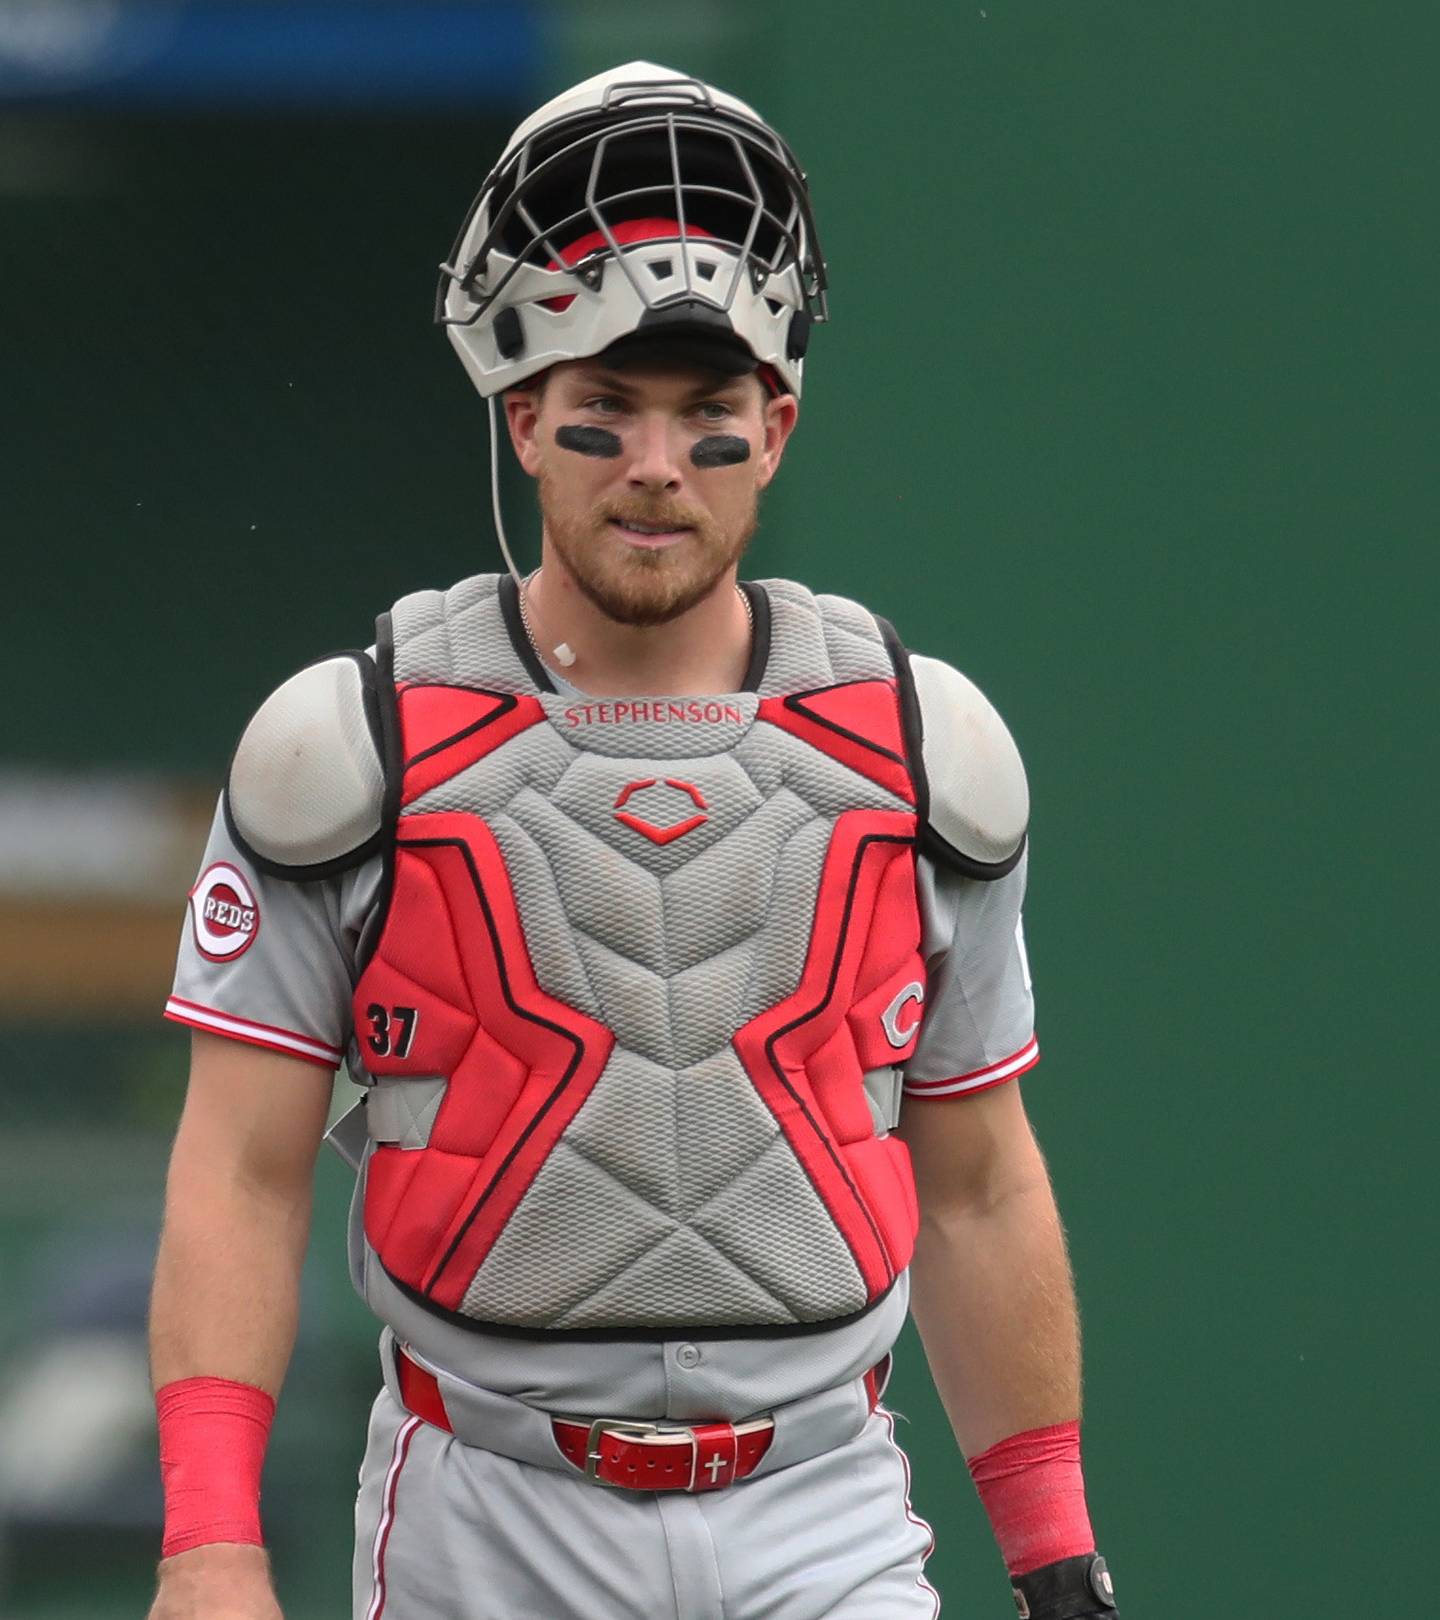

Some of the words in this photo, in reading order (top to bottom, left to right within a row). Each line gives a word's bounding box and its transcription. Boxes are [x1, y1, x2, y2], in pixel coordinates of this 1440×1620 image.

[564, 702, 743, 728] STEPHENSON
[204, 897, 255, 933] REDS
[367, 1003, 418, 1059] 37
[880, 981, 924, 1049] C
